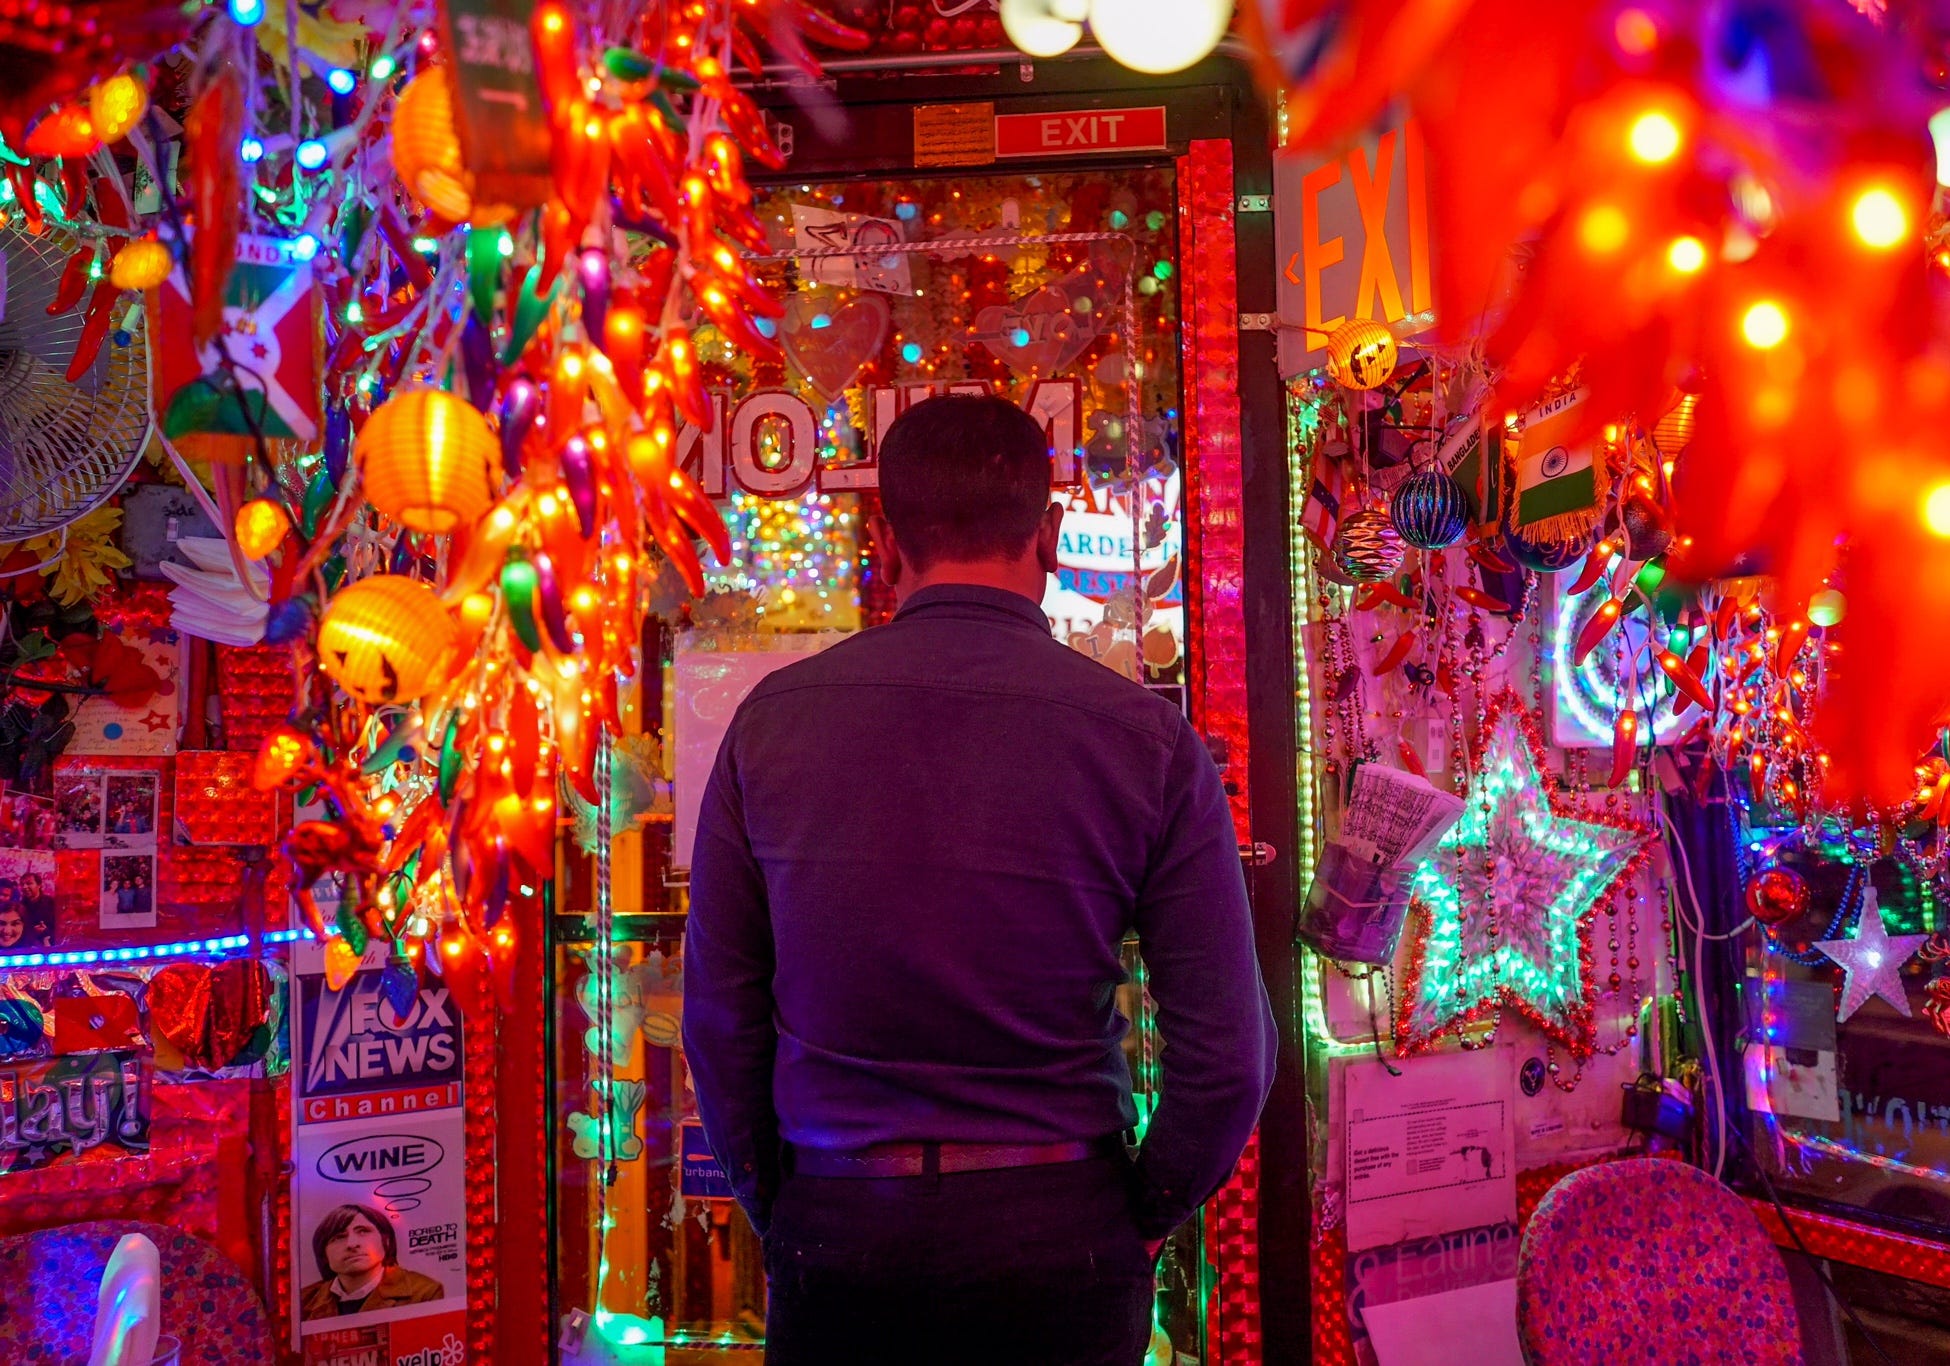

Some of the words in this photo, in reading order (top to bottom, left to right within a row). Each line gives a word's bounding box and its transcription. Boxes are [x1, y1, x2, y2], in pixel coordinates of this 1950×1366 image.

[1041, 116, 1125, 147] EXIT
[1302, 117, 1432, 353] EXI
[1539, 392, 1577, 418] INDIA
[1057, 533, 1134, 558] ARDE
[351, 988, 454, 1035] FOX
[325, 1033, 456, 1082] NEWS
[0, 1058, 140, 1157] ay!
[309, 1085, 454, 1120] Channel
[334, 1144, 425, 1174] WINE
[685, 1167, 726, 1178] urbans
[409, 1225, 442, 1238] BORED
[444, 1223, 458, 1231] TO
[409, 1230, 457, 1248] DEATH
[397, 1348, 442, 1366] yelp
